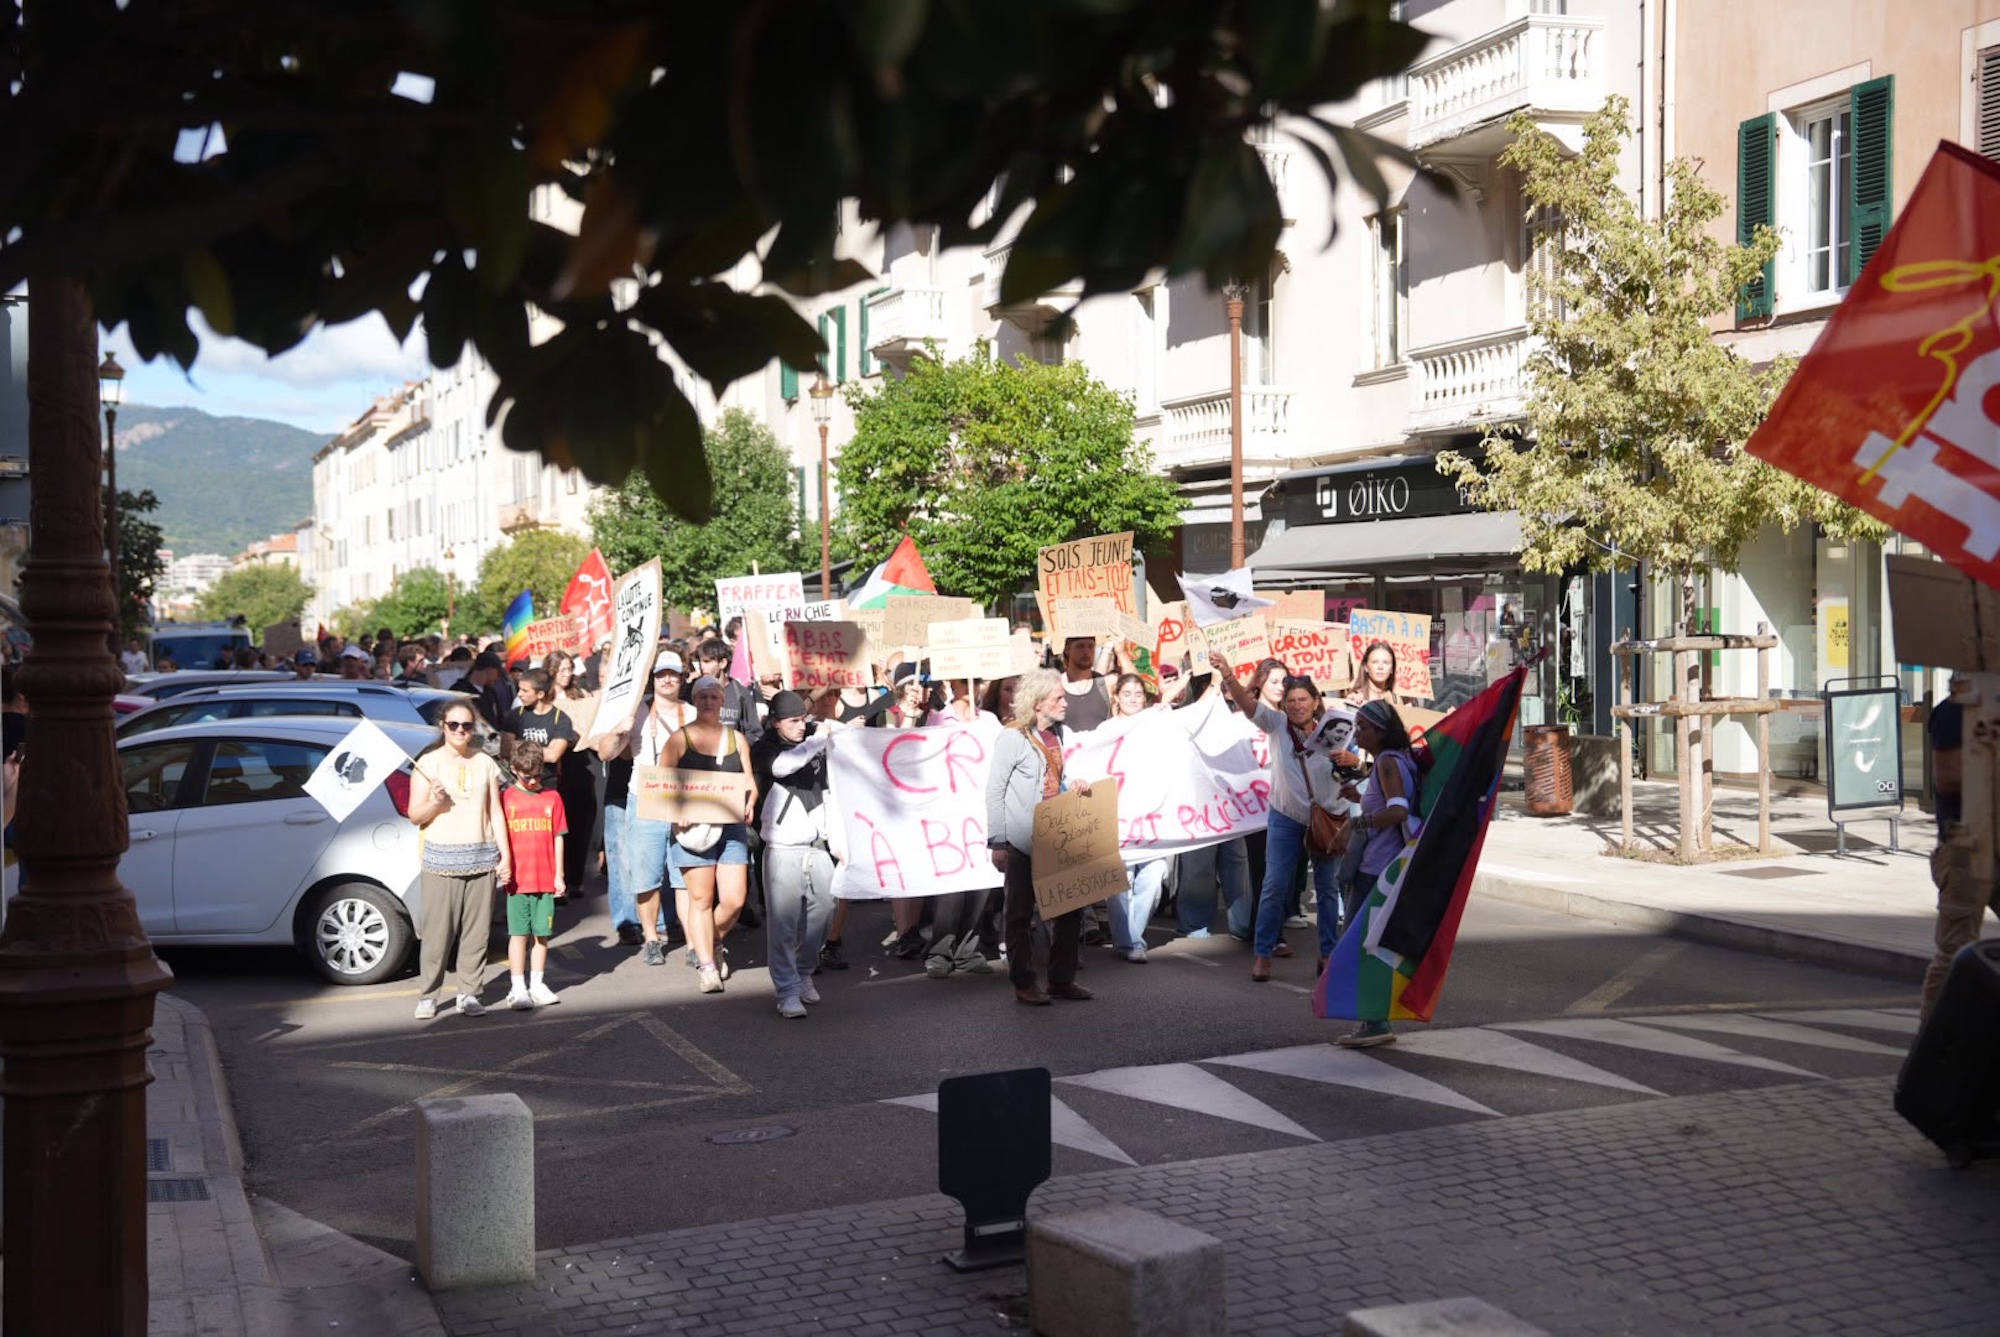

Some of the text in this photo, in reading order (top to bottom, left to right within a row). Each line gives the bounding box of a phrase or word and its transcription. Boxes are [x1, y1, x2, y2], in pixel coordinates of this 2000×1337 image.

[722, 584, 800, 603] FRAPPER
[1046, 572, 1061, 597] ET
[622, 593, 652, 622] CONTINUE
[769, 611, 782, 623] LE
[784, 607, 801, 619] RN
[804, 604, 831, 621] CHIE
[1351, 612, 1396, 634] BASTA
[803, 629, 842, 649] BAS
[1291, 649, 1340, 665] TOUT
[508, 817, 552, 832] PORTUGA
[921, 816, 990, 877] BA
